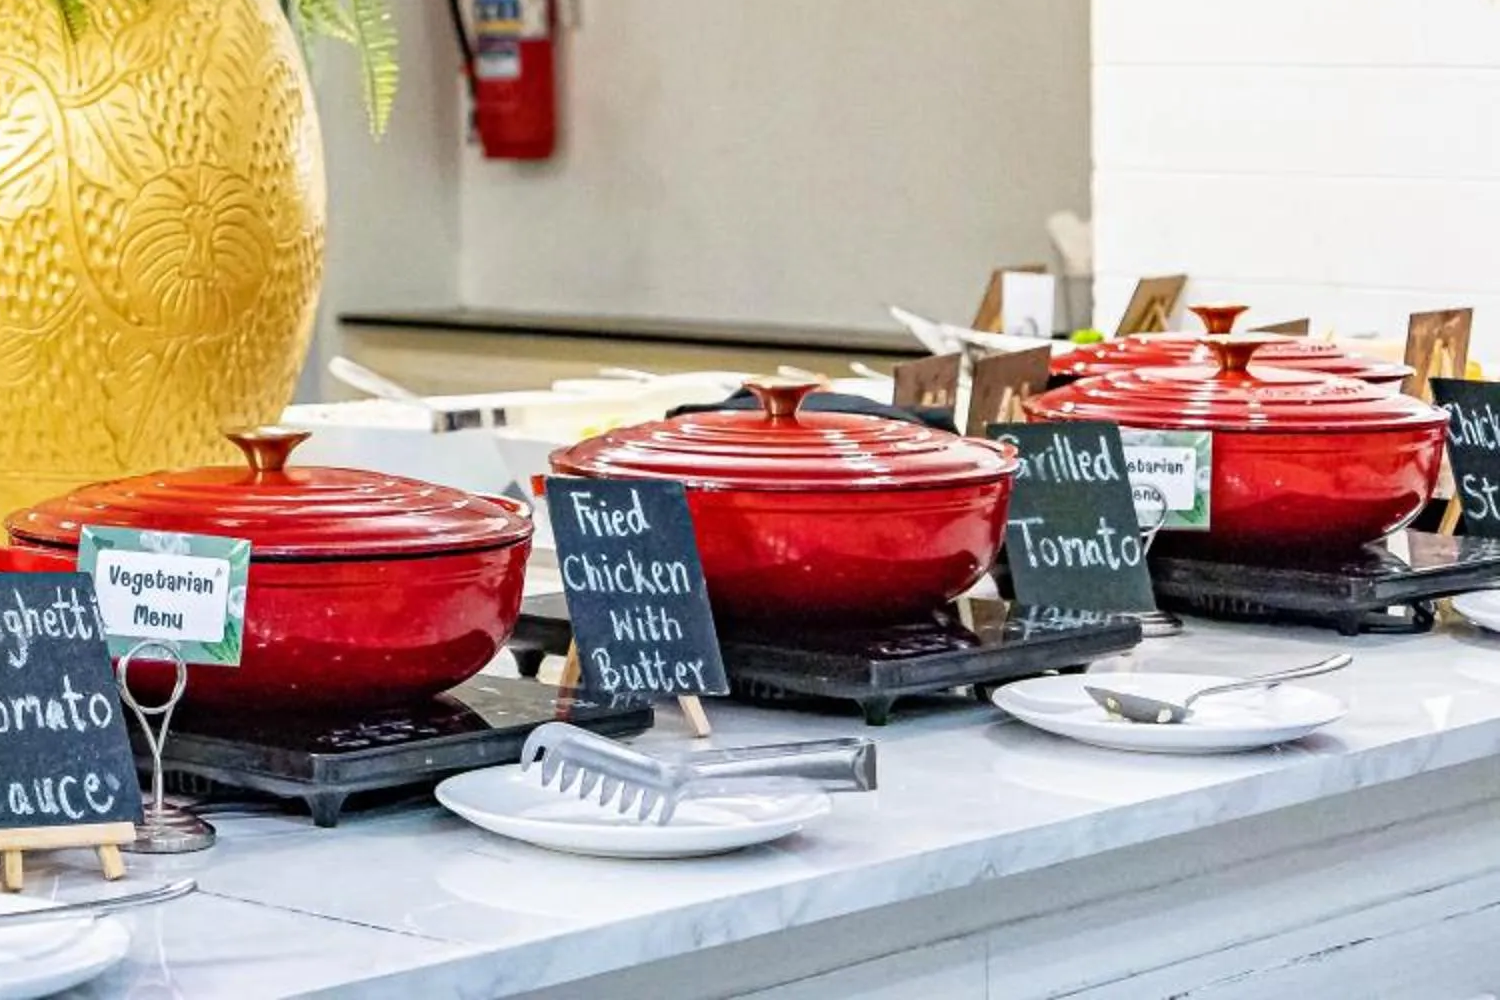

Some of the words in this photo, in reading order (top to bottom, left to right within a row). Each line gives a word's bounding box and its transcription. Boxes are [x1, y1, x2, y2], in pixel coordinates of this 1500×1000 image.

[1126, 457, 1184, 476] etarian
[570, 488, 650, 537] Fried
[1133, 489, 1162, 502] enu
[1007, 517, 1141, 571] Tomato
[109, 565, 214, 596] Vegetarian
[563, 550, 691, 596] Chicken
[133, 604, 184, 631] Menu
[610, 605, 683, 642] With
[591, 647, 706, 692] Butter
